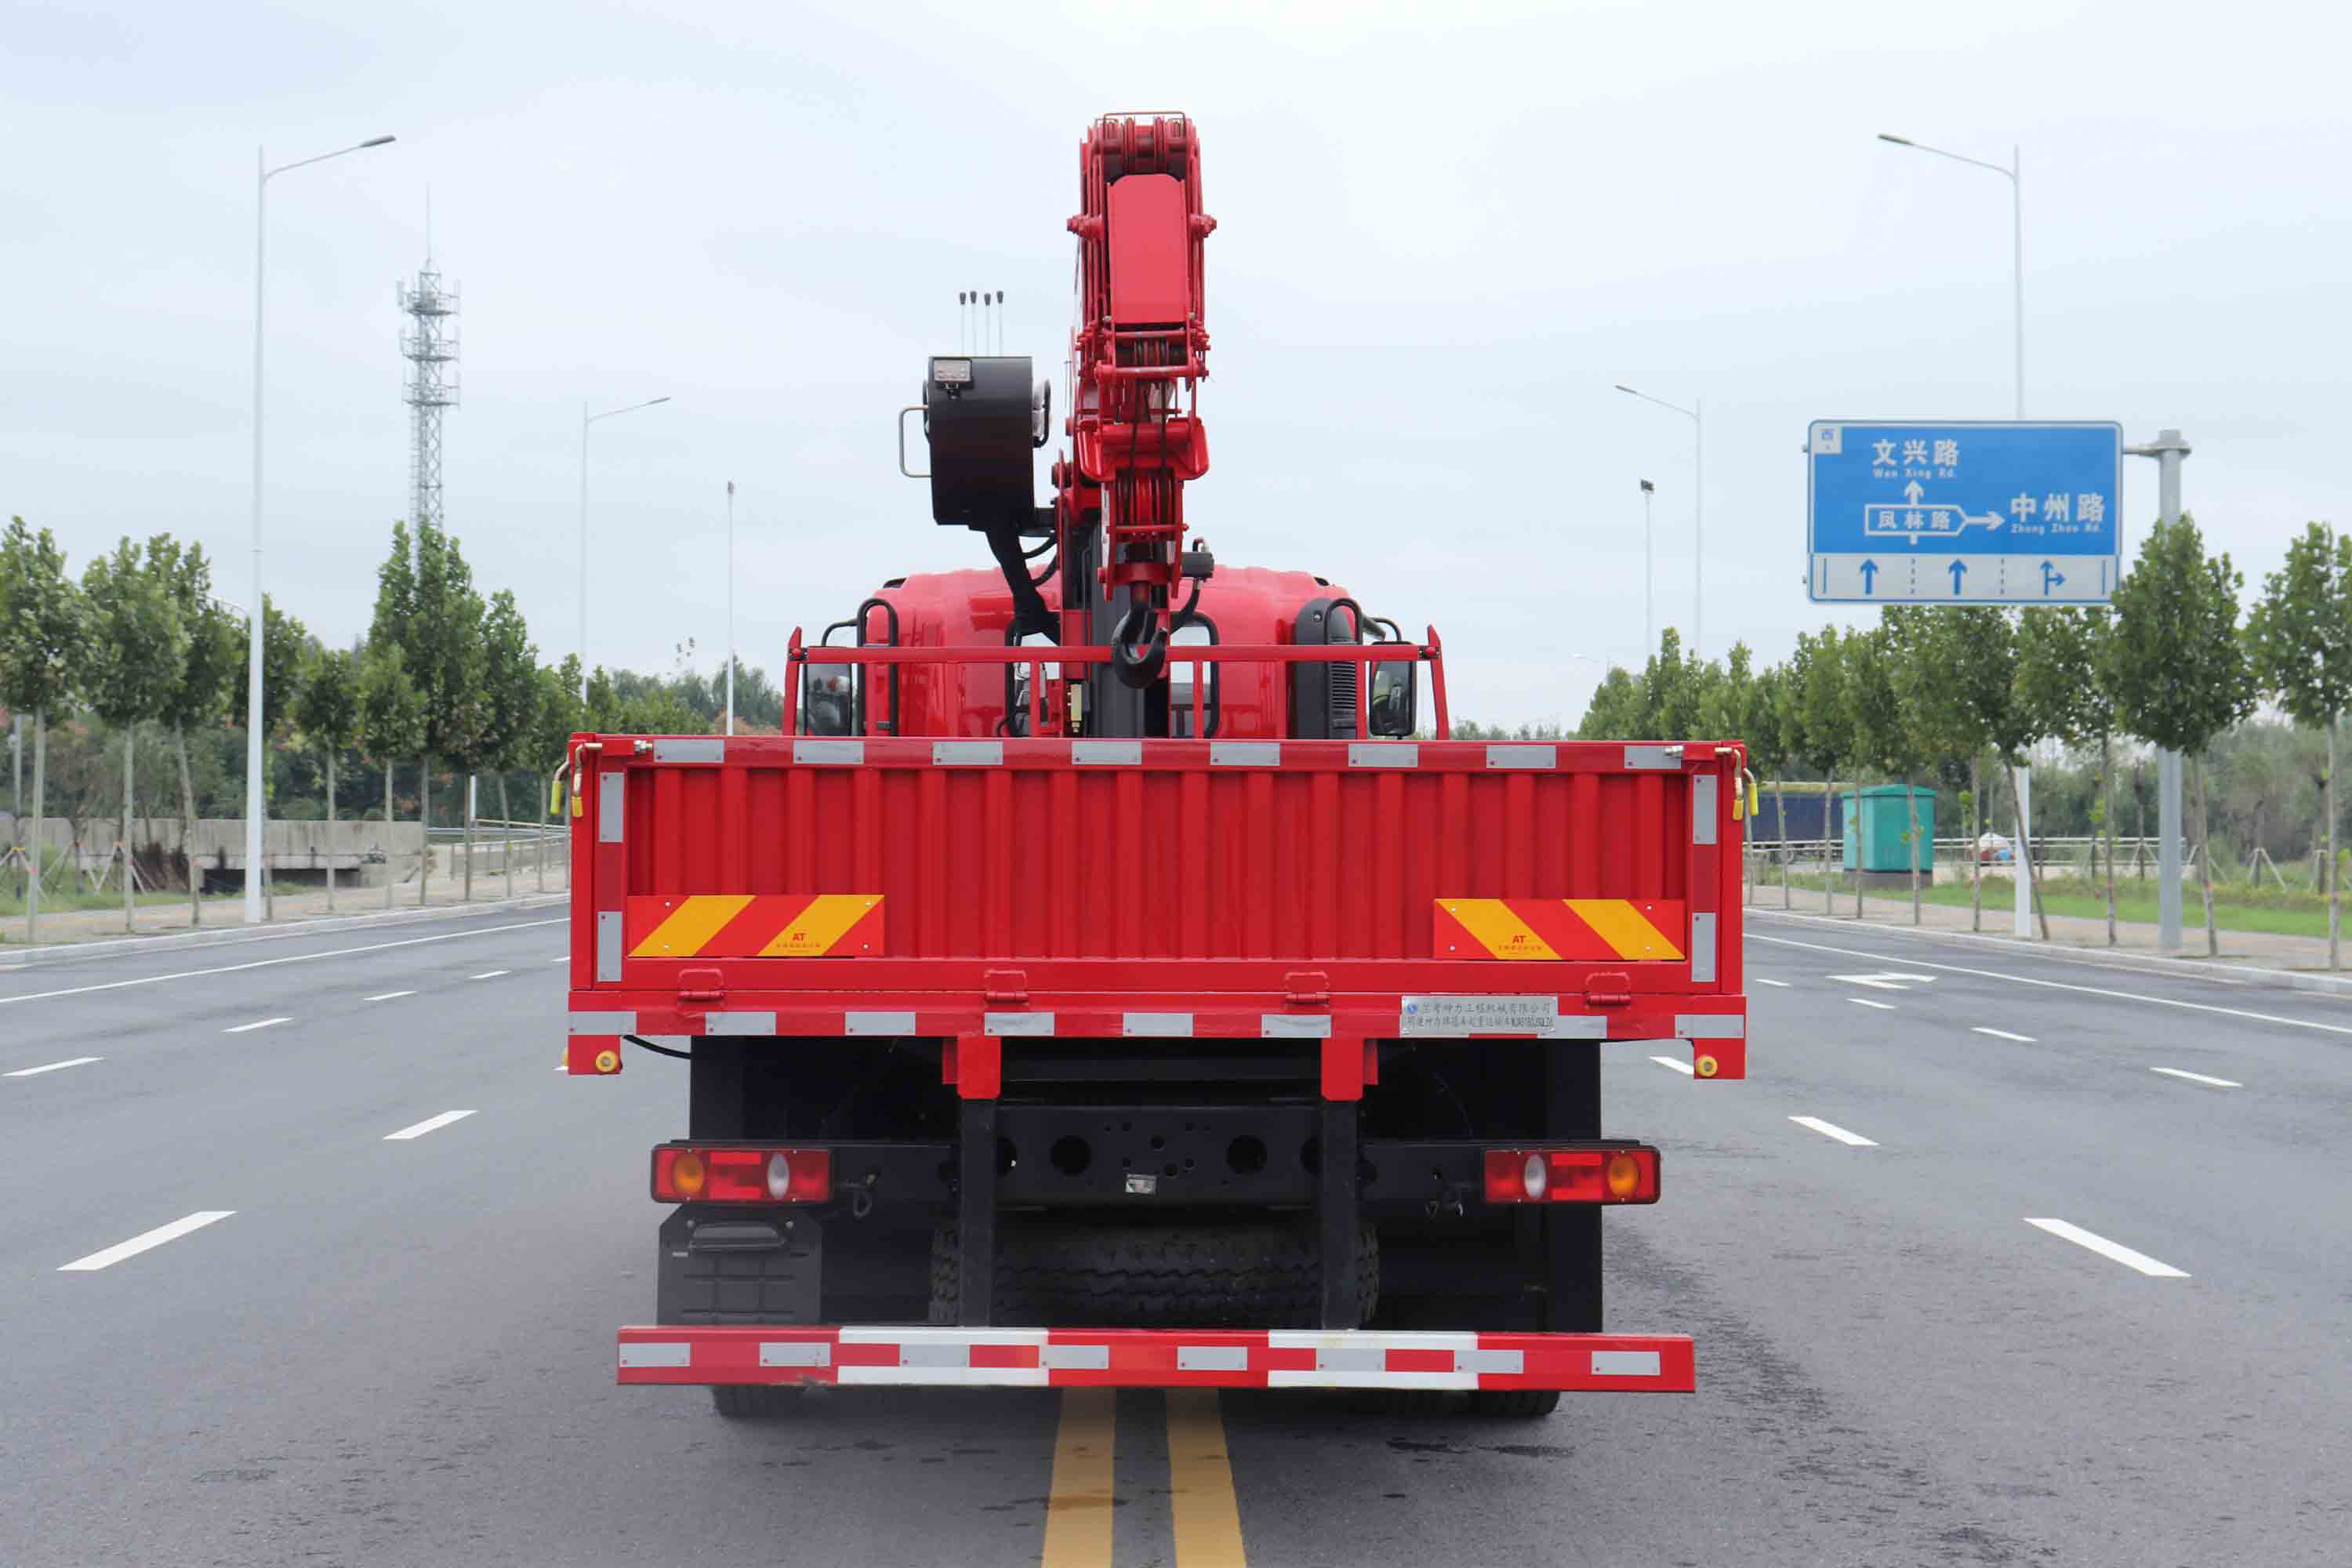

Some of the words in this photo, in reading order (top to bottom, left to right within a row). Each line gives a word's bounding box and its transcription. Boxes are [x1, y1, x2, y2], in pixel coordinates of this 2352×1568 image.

[1872, 439, 1958, 466] 文兴路
[1905, 468, 1932, 480] Xing
[2010, 492, 2105, 522] 中州路
[792, 933, 807, 942] AT
[1512, 935, 1527, 943] AT
